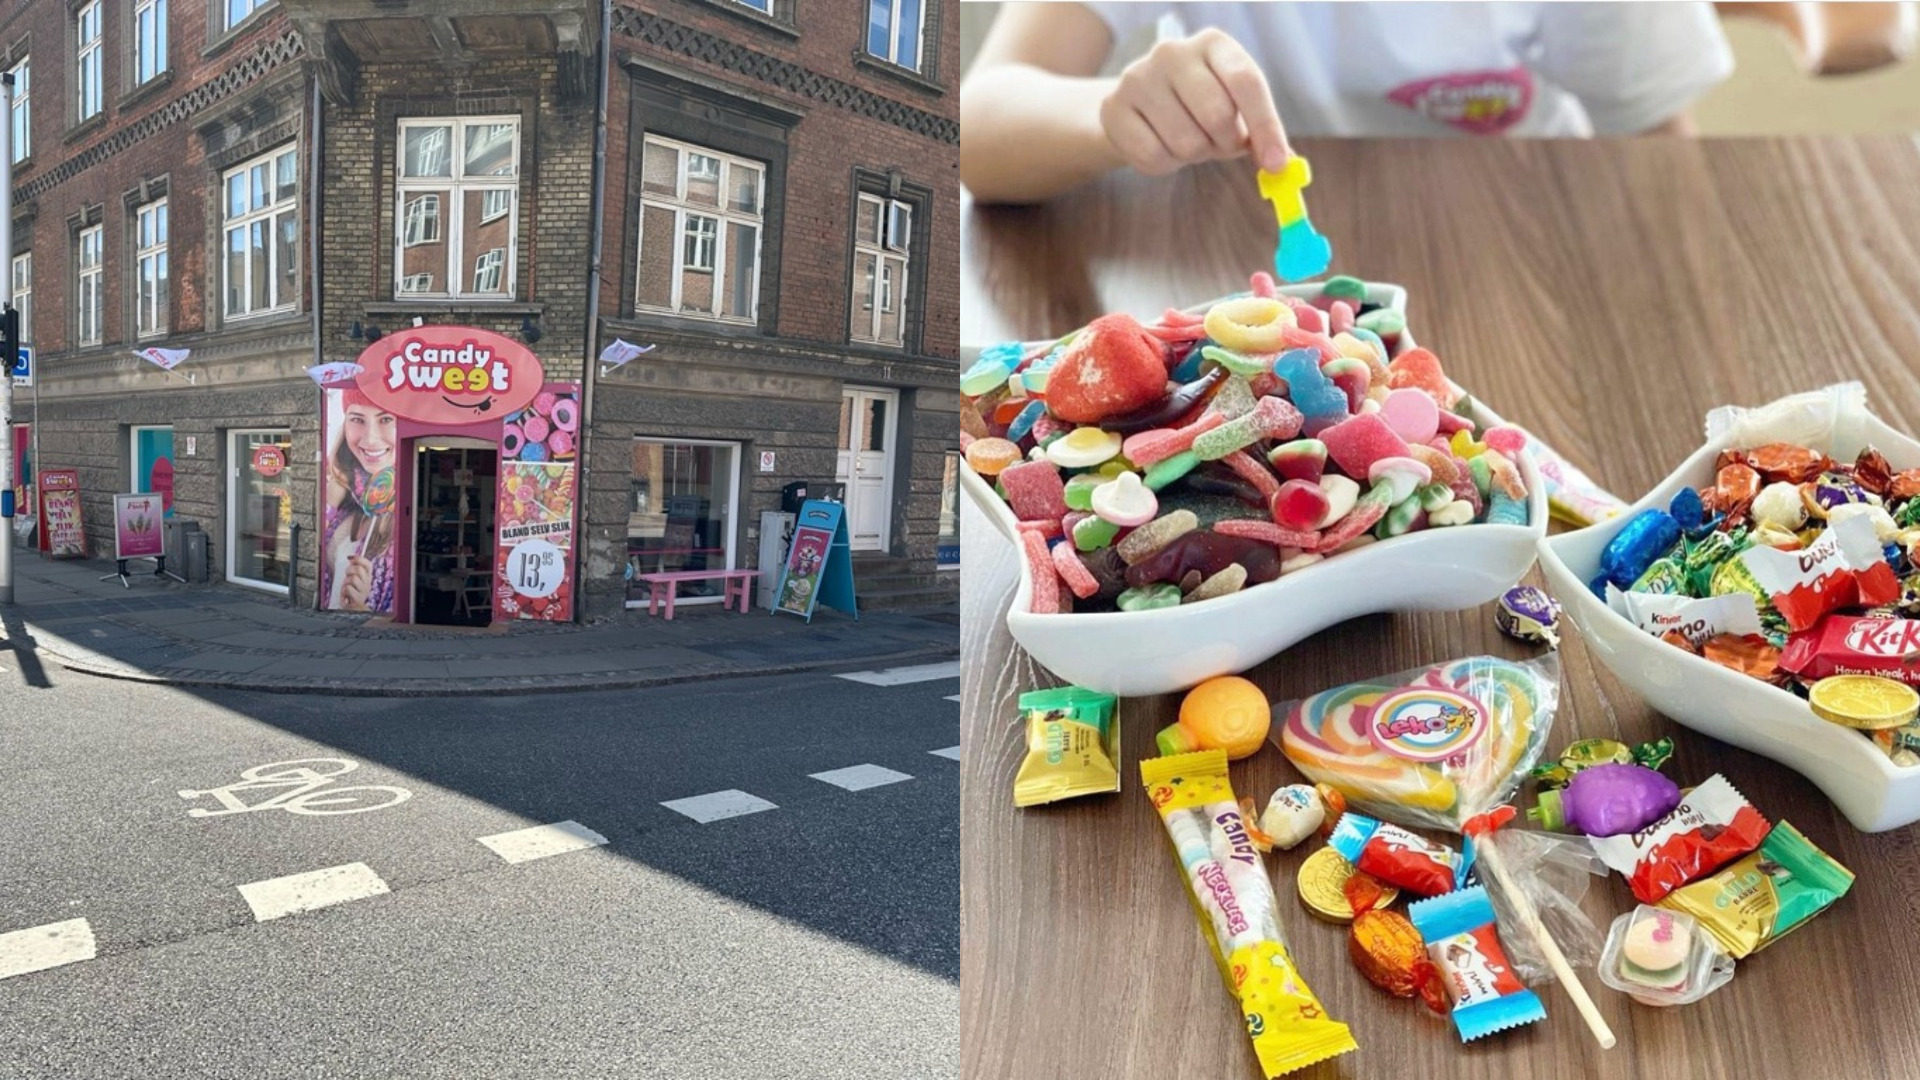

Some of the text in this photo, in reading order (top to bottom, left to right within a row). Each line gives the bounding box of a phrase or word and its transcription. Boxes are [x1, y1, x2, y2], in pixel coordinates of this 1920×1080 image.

[388, 355, 508, 391] Sweet
[405, 342, 490, 368] Candy
[502, 521, 570, 538] BLAND SELV SLIK
[1046, 723, 1064, 764] GULD
[1216, 812, 1258, 866] Candy
[1714, 872, 1762, 910] GULD
